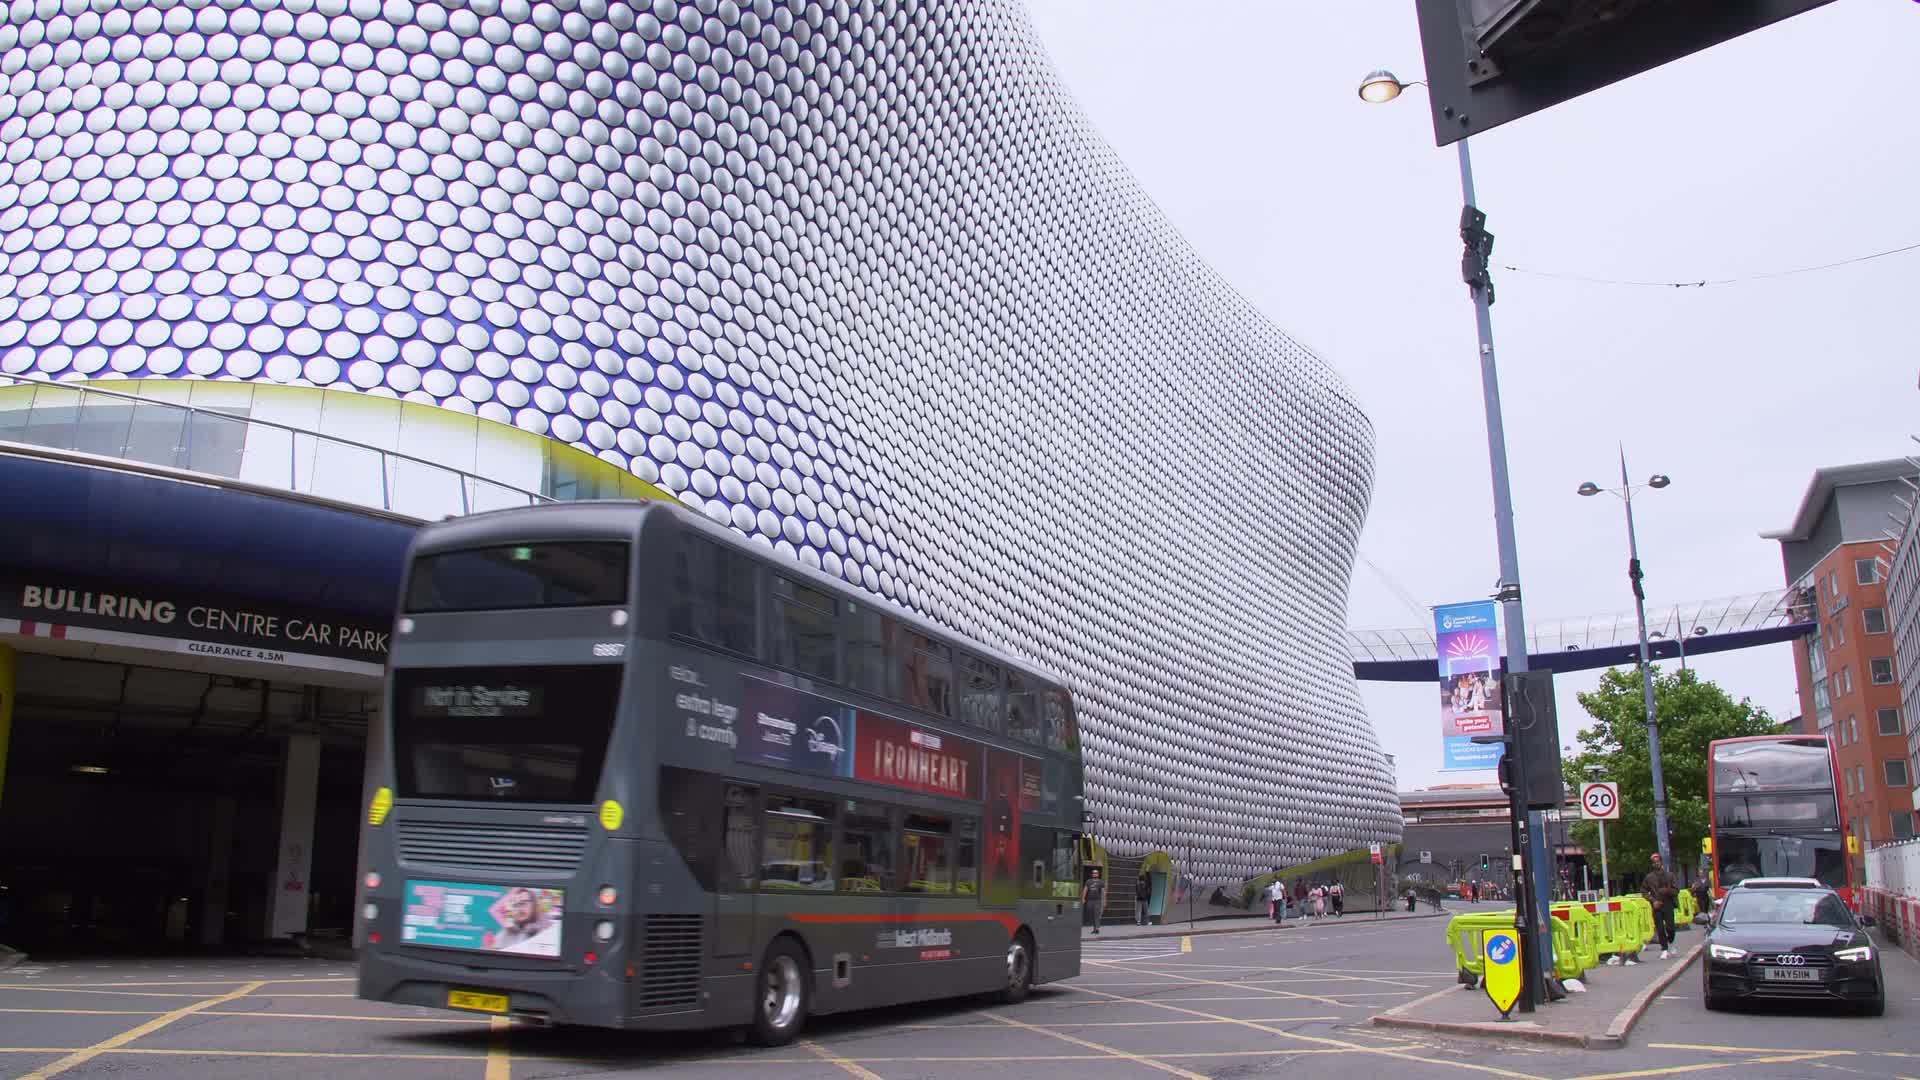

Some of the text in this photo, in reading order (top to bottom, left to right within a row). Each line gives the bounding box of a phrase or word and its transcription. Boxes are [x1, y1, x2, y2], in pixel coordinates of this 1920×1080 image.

[22, 584, 390, 653] BULLRING CENTRE CAR PARK
[188, 642, 285, 662] CLEARANCE 4.5M
[874, 739, 969, 794] IRONHEART
[1589, 793, 1612, 807] 20
